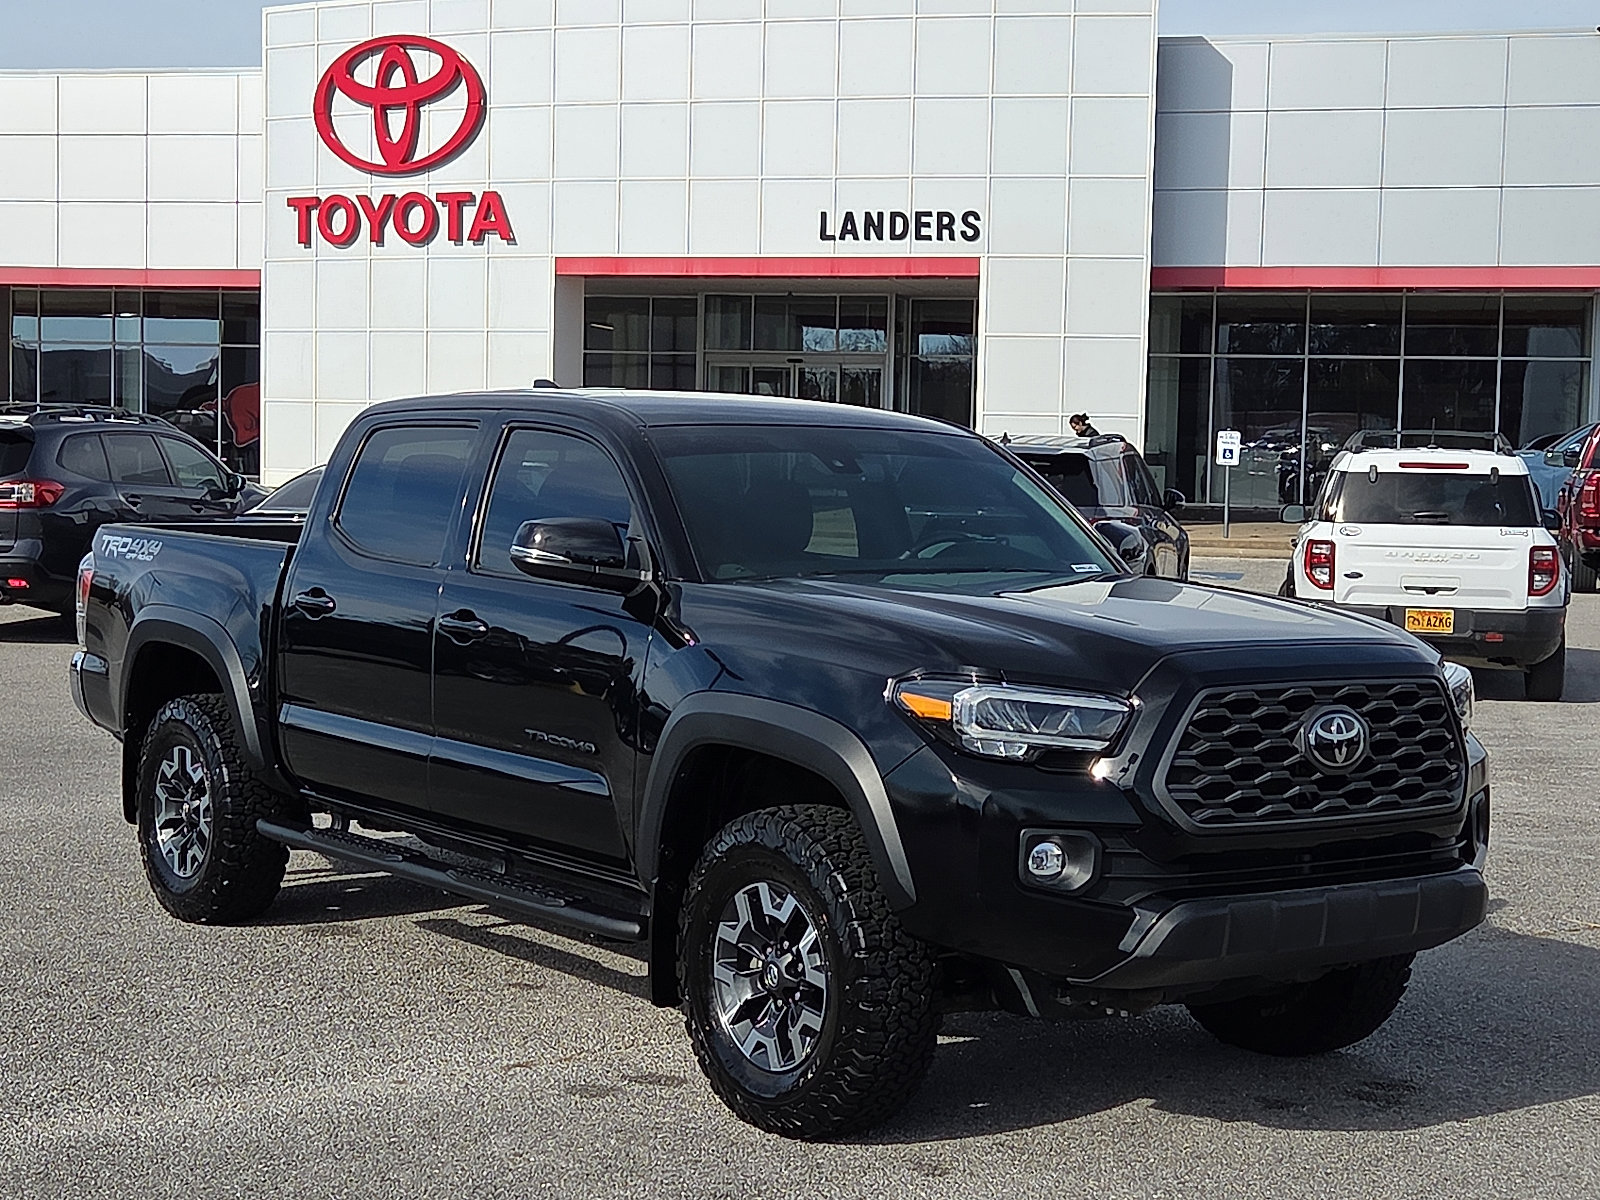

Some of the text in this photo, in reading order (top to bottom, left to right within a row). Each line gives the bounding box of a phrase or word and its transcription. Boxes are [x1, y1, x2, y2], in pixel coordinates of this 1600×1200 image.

[287, 191, 517, 248] TOYOTA
[819, 210, 982, 242] LANDERS
[102, 535, 132, 558] TRD
[524, 728, 596, 754] TACOMA
